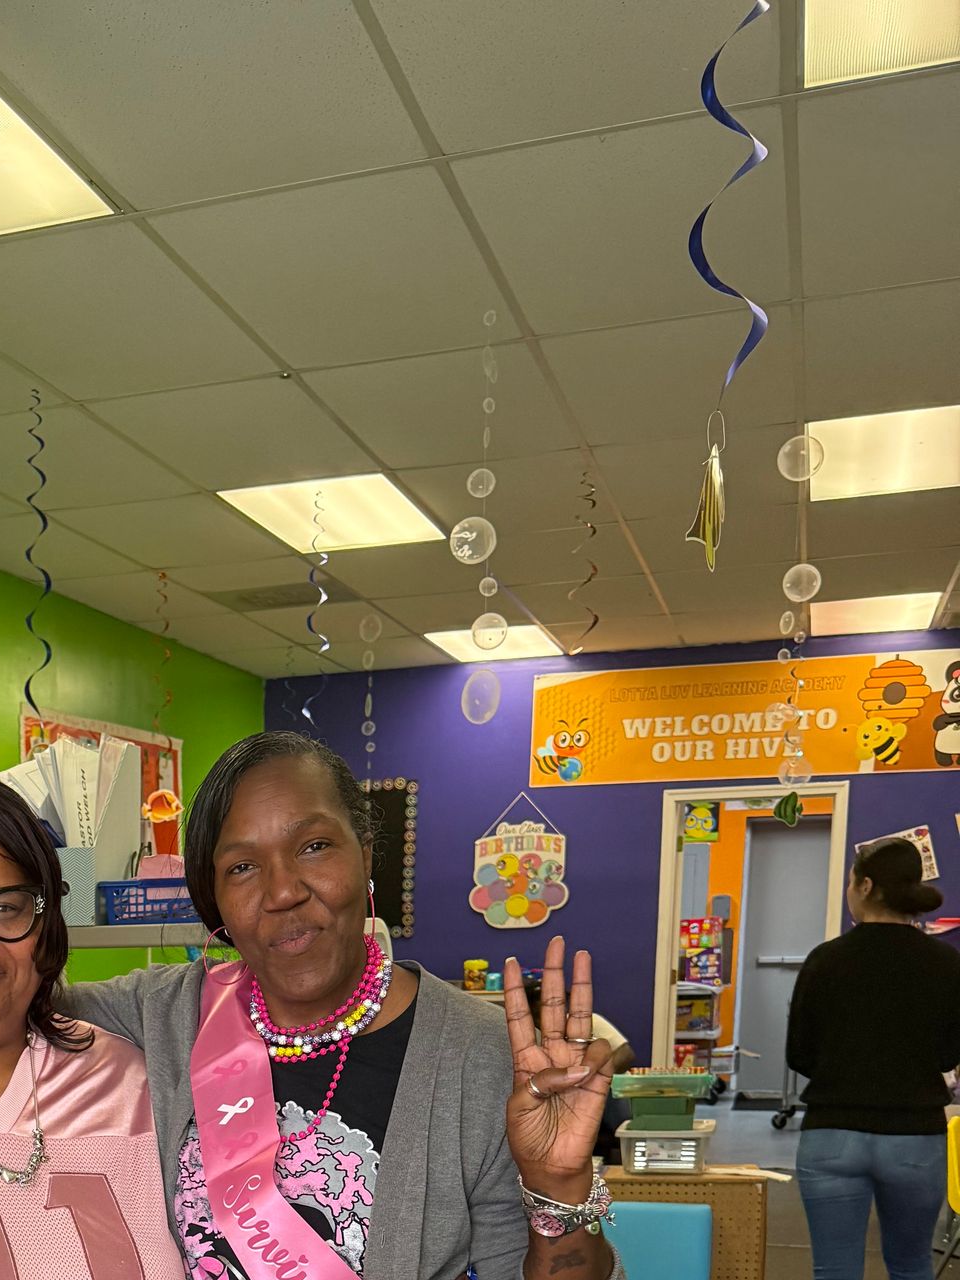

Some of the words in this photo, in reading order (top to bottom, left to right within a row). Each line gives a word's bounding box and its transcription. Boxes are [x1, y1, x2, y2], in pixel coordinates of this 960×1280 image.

[609, 686, 656, 703] LOTTA
[661, 684, 690, 701] LUV
[692, 679, 768, 699] LEARNING
[769, 675, 846, 694] ACADEMY
[622, 711, 785, 739] WELCOME
[797, 707, 838, 731] TO
[651, 739, 715, 763] OUR
[725, 735, 803, 760] HIVE
[81, 768, 91, 823] WELCH
[76, 800, 86, 847] ASTOR
[479, 835, 562, 858] BIRTHDAYS
